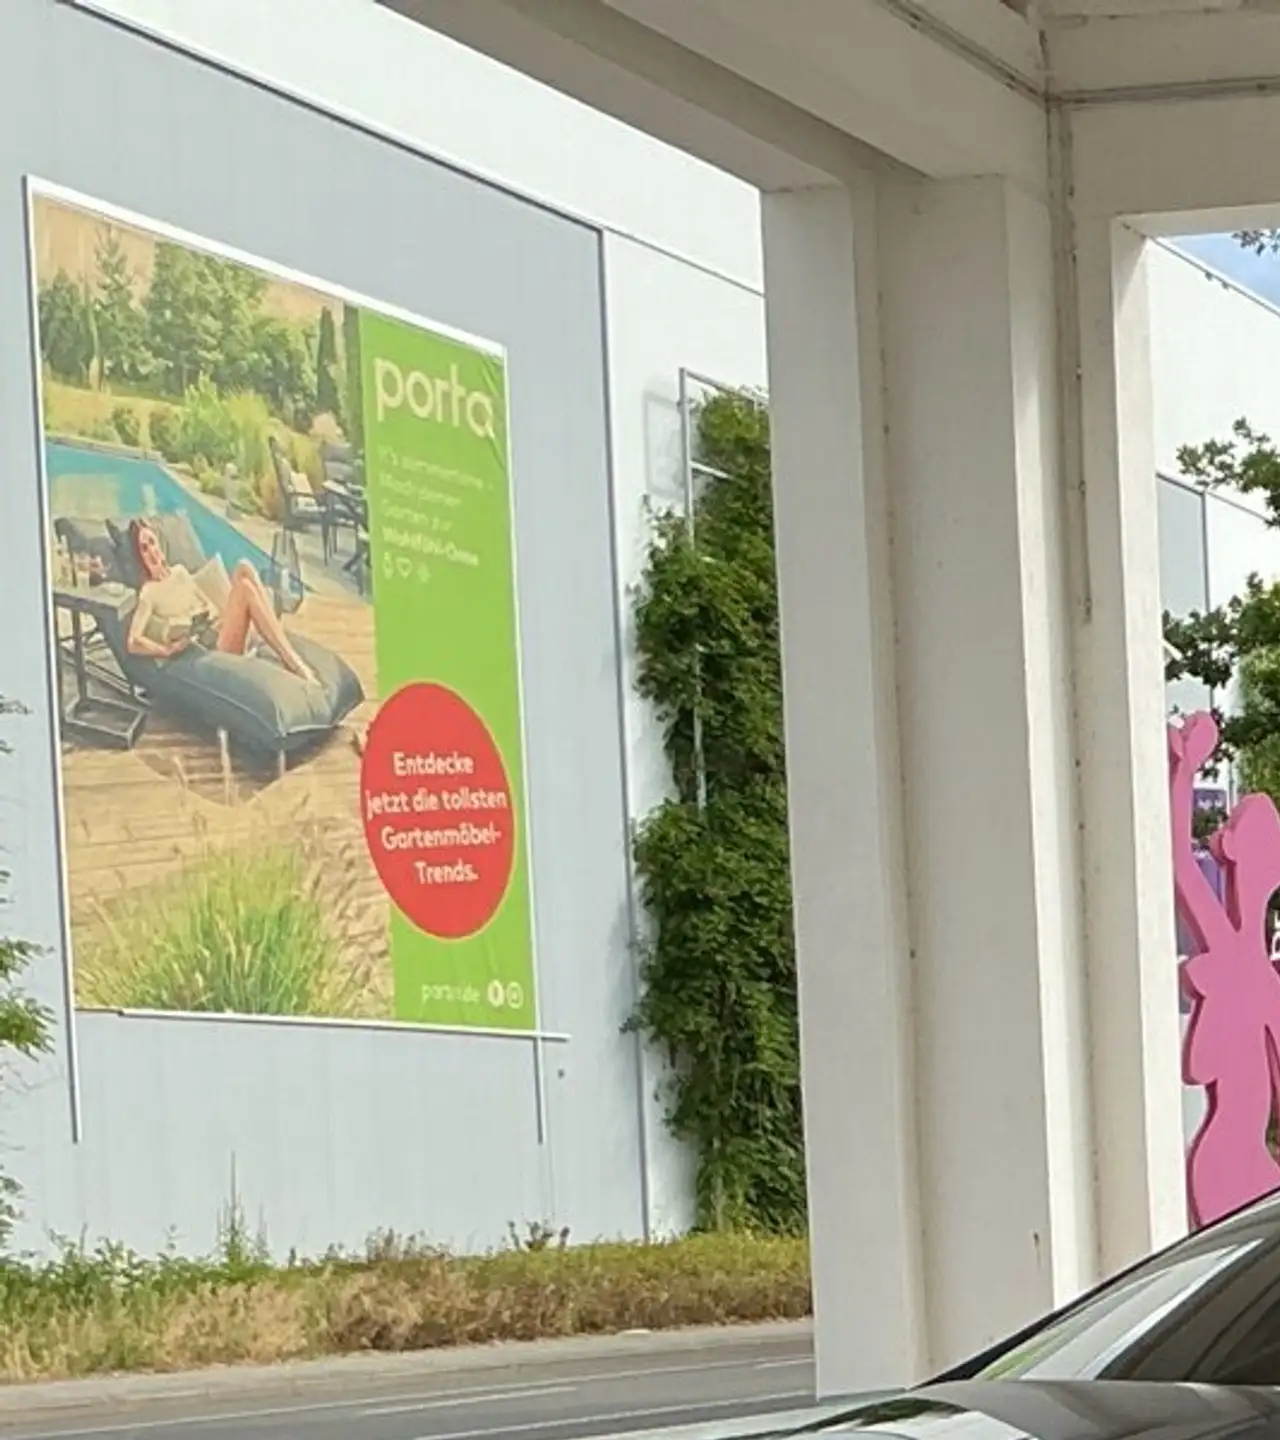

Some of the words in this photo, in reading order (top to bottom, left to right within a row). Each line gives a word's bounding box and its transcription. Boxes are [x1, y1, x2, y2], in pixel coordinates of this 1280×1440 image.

[373, 357, 496, 438] porta
[393, 751, 475, 777] Entdecke
[365, 789, 410, 821] jetzt
[411, 787, 440, 811] die
[442, 786, 509, 811] tollsten
[380, 822, 502, 850] Gartenmöbel-
[413, 858, 480, 884] Trends.
